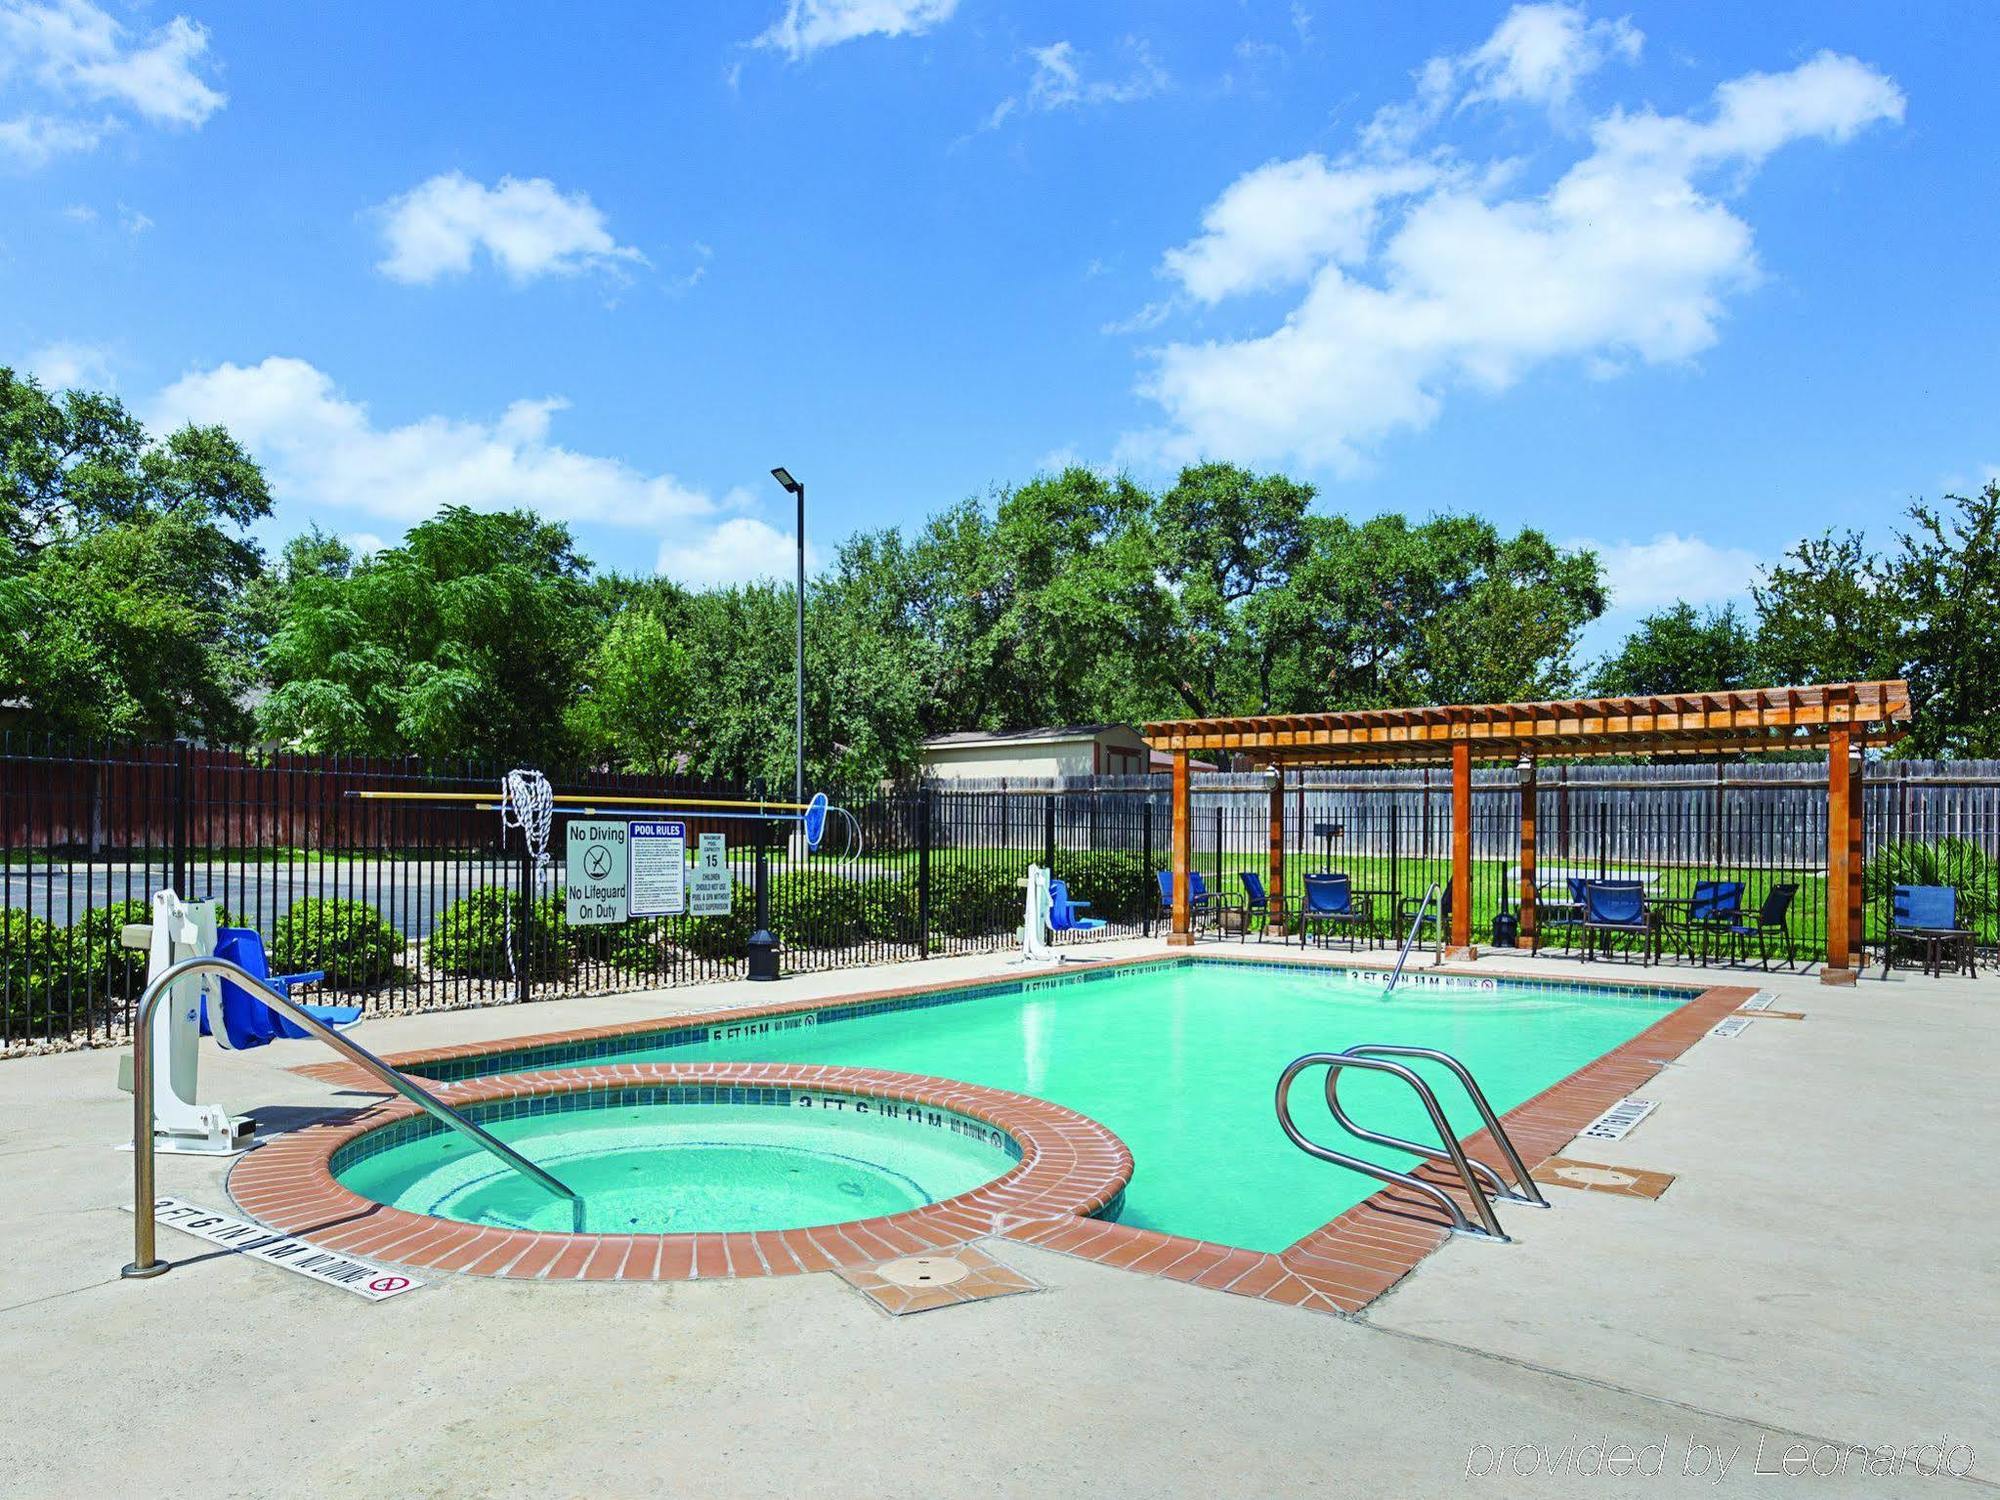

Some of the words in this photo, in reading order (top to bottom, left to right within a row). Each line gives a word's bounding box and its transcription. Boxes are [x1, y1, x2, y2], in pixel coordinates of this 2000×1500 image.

[570, 826, 586, 841] No
[590, 826, 625, 844] Diving
[634, 825, 655, 835] POOL
[656, 825, 680, 835] RULES
[706, 854, 718, 867] 15
[702, 873, 720, 881] CHILDREN
[569, 886, 582, 900] No
[584, 884, 626, 902] Lifeguard
[695, 883, 711, 891] SHOULD
[711, 883, 719, 891] NOT
[692, 893, 701, 901] POOL
[580, 905, 593, 919] On
[597, 904, 617, 920] Duty
[1363, 972, 1377, 980] FT
[1429, 977, 1439, 985] M
[727, 1027, 741, 1039] FT
[759, 1022, 769, 1034] M
[880, 1103, 898, 1118] IN
[928, 1112, 942, 1127] M
[950, 1117, 961, 1134] NO
[963, 1121, 987, 1143] DIVING
[154, 1207, 206, 1221] FT
[187, 1217, 224, 1228] 6
[207, 1224, 258, 1241] IN
[261, 1243, 310, 1260] M
[291, 1253, 336, 1269] NO
[311, 1260, 379, 1284] DIVING
